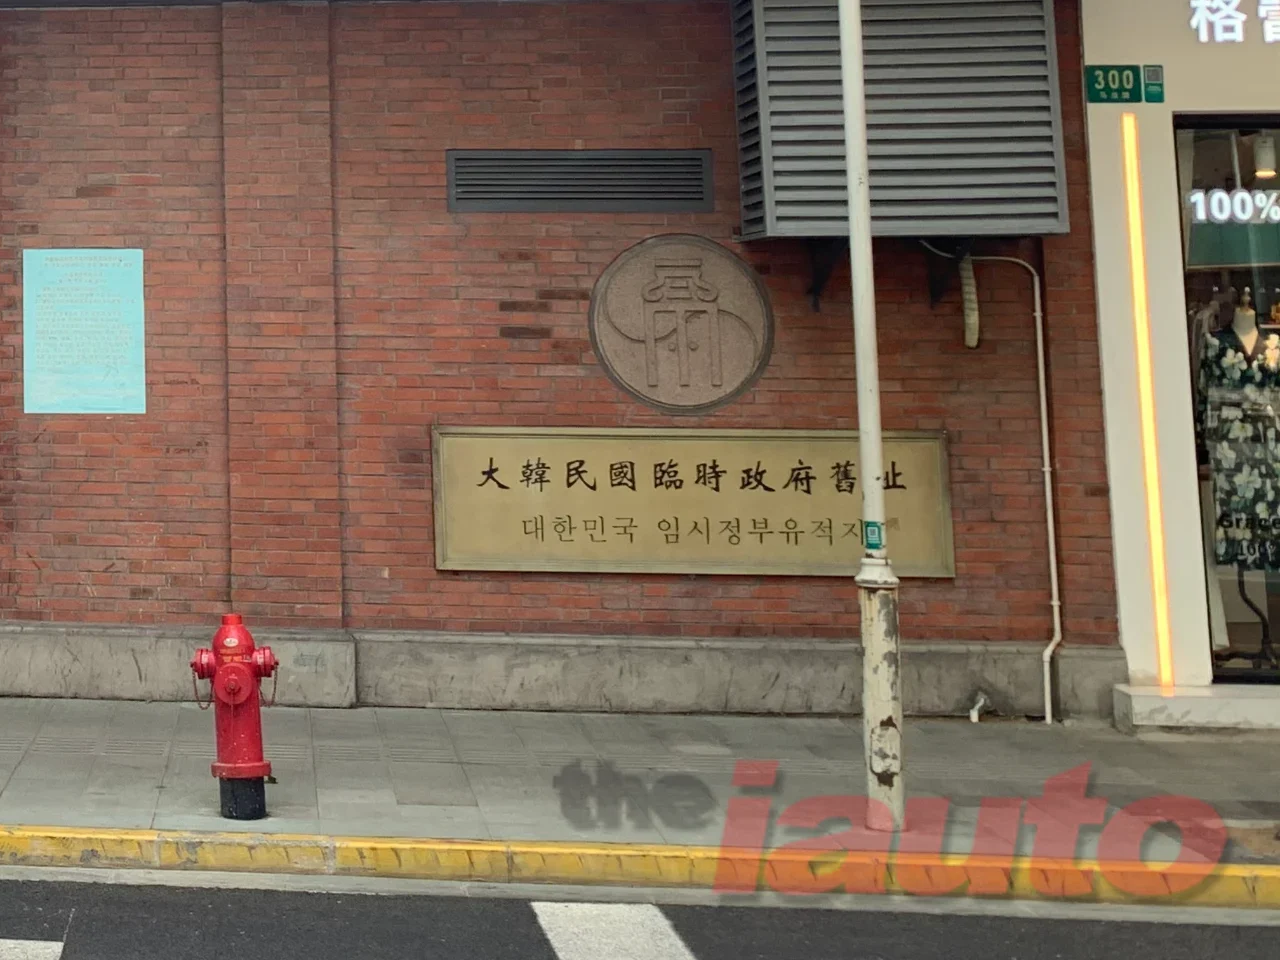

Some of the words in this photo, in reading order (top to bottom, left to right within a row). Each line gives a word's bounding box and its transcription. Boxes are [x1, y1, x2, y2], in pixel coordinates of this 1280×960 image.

[1094, 69, 1134, 89] 300
[1190, 191, 1280, 223] 100%
[522, 514, 639, 544] 대한민국
[657, 515, 864, 547] 임시정부유적지
